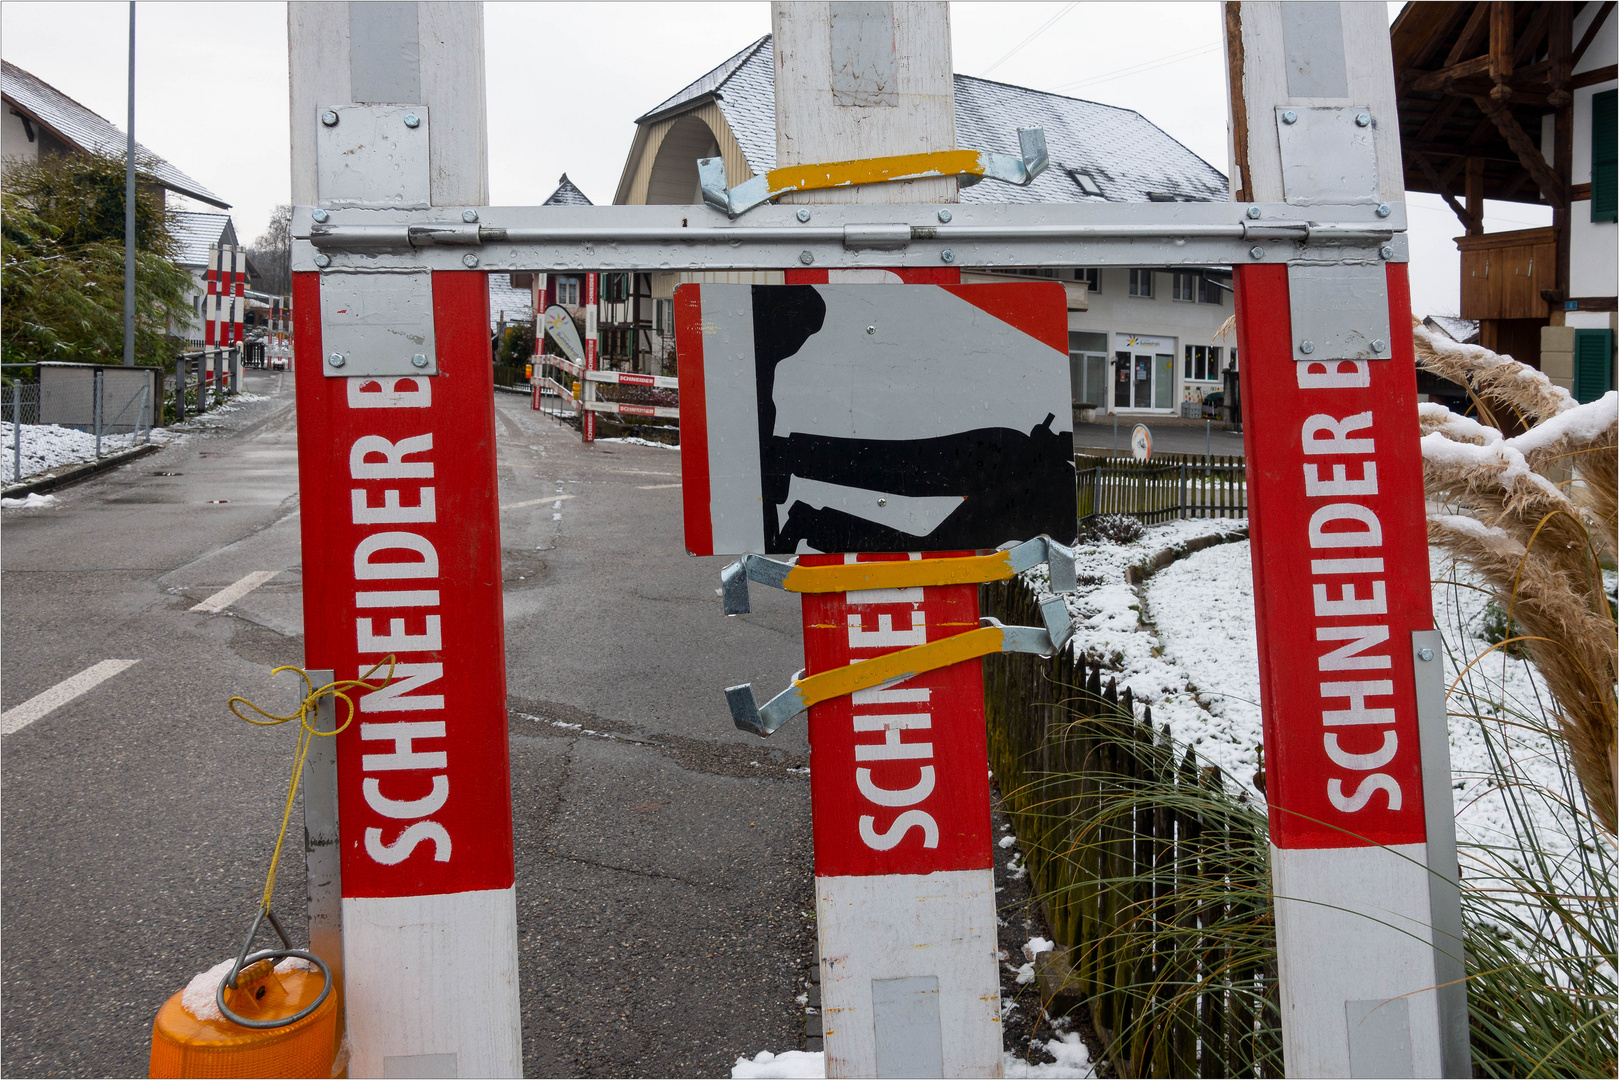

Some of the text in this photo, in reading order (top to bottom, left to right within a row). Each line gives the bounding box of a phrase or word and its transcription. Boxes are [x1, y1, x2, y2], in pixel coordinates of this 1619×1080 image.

[619, 376, 654, 384] SCHNEIDER
[346, 375, 452, 867] SCHNEIDER B
[844, 552, 939, 851] SCHNEI
[1296, 360, 1403, 813] SCHNEIDER B
